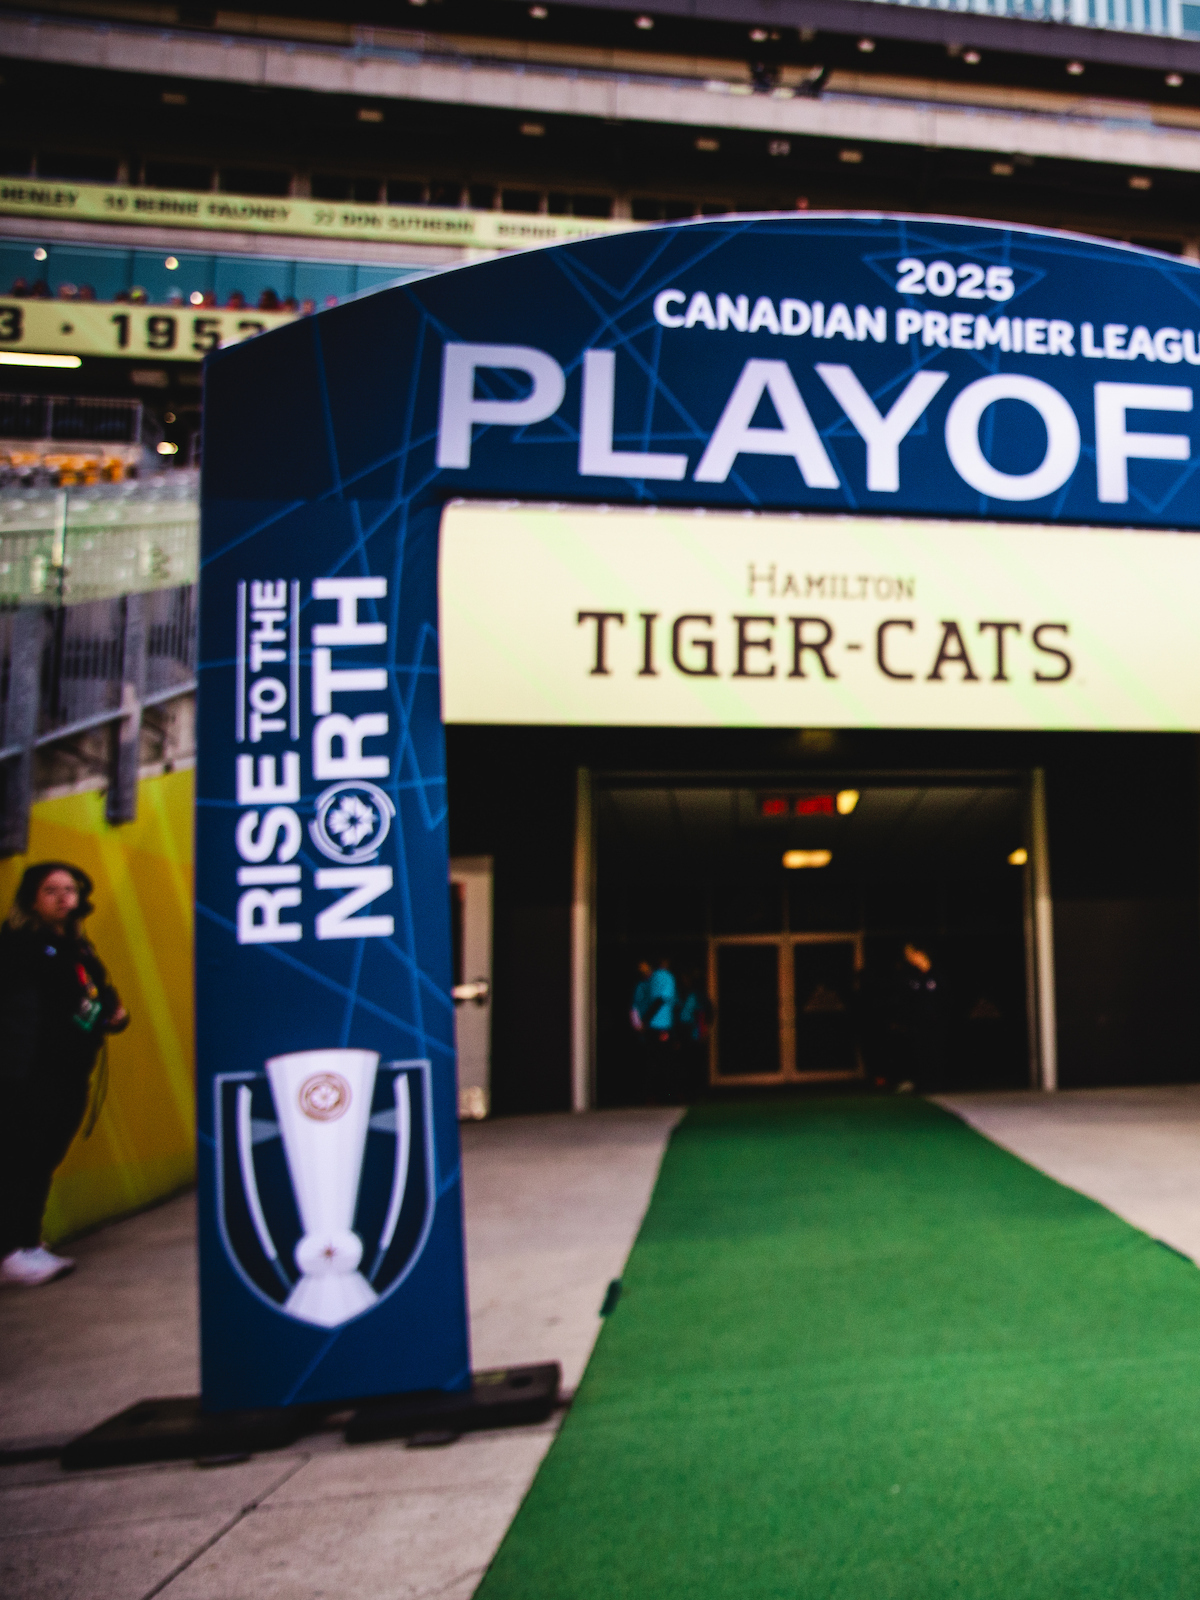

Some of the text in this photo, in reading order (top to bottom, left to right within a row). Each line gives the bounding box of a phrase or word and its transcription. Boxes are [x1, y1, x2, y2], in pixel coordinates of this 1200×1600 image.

[897, 258, 1015, 301] 2025
[654, 288, 886, 343] CANADIAN
[898, 306, 1074, 358] PREMIER
[747, 562, 916, 600] HAMILTON
[576, 610, 1074, 683] TIGER-CATS
[235, 578, 303, 945] RISE TO THE
